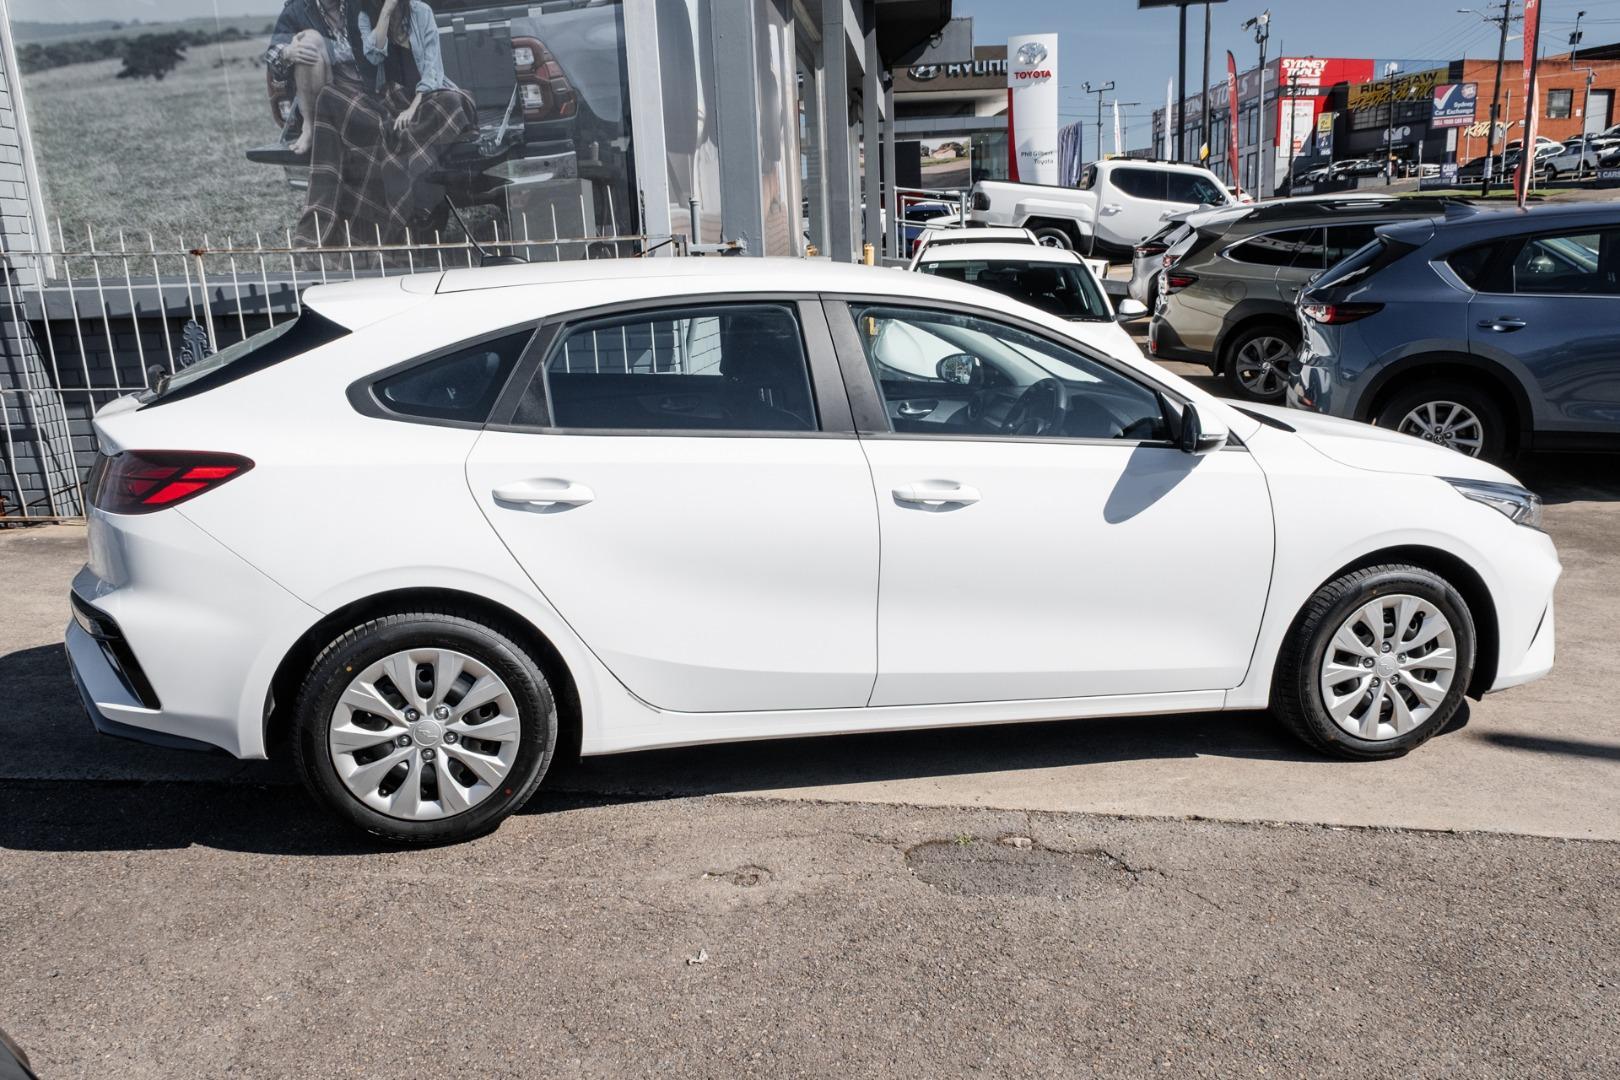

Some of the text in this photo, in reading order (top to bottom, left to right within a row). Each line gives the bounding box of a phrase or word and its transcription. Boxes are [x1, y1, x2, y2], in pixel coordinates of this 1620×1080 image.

[949, 60, 1008, 74] HYUN
[1282, 59, 1328, 69] SYDNEY
[1014, 70, 1051, 79] TOYOTA
[1287, 68, 1323, 77] TOOLS
[1033, 150, 1054, 158] Gilbert
